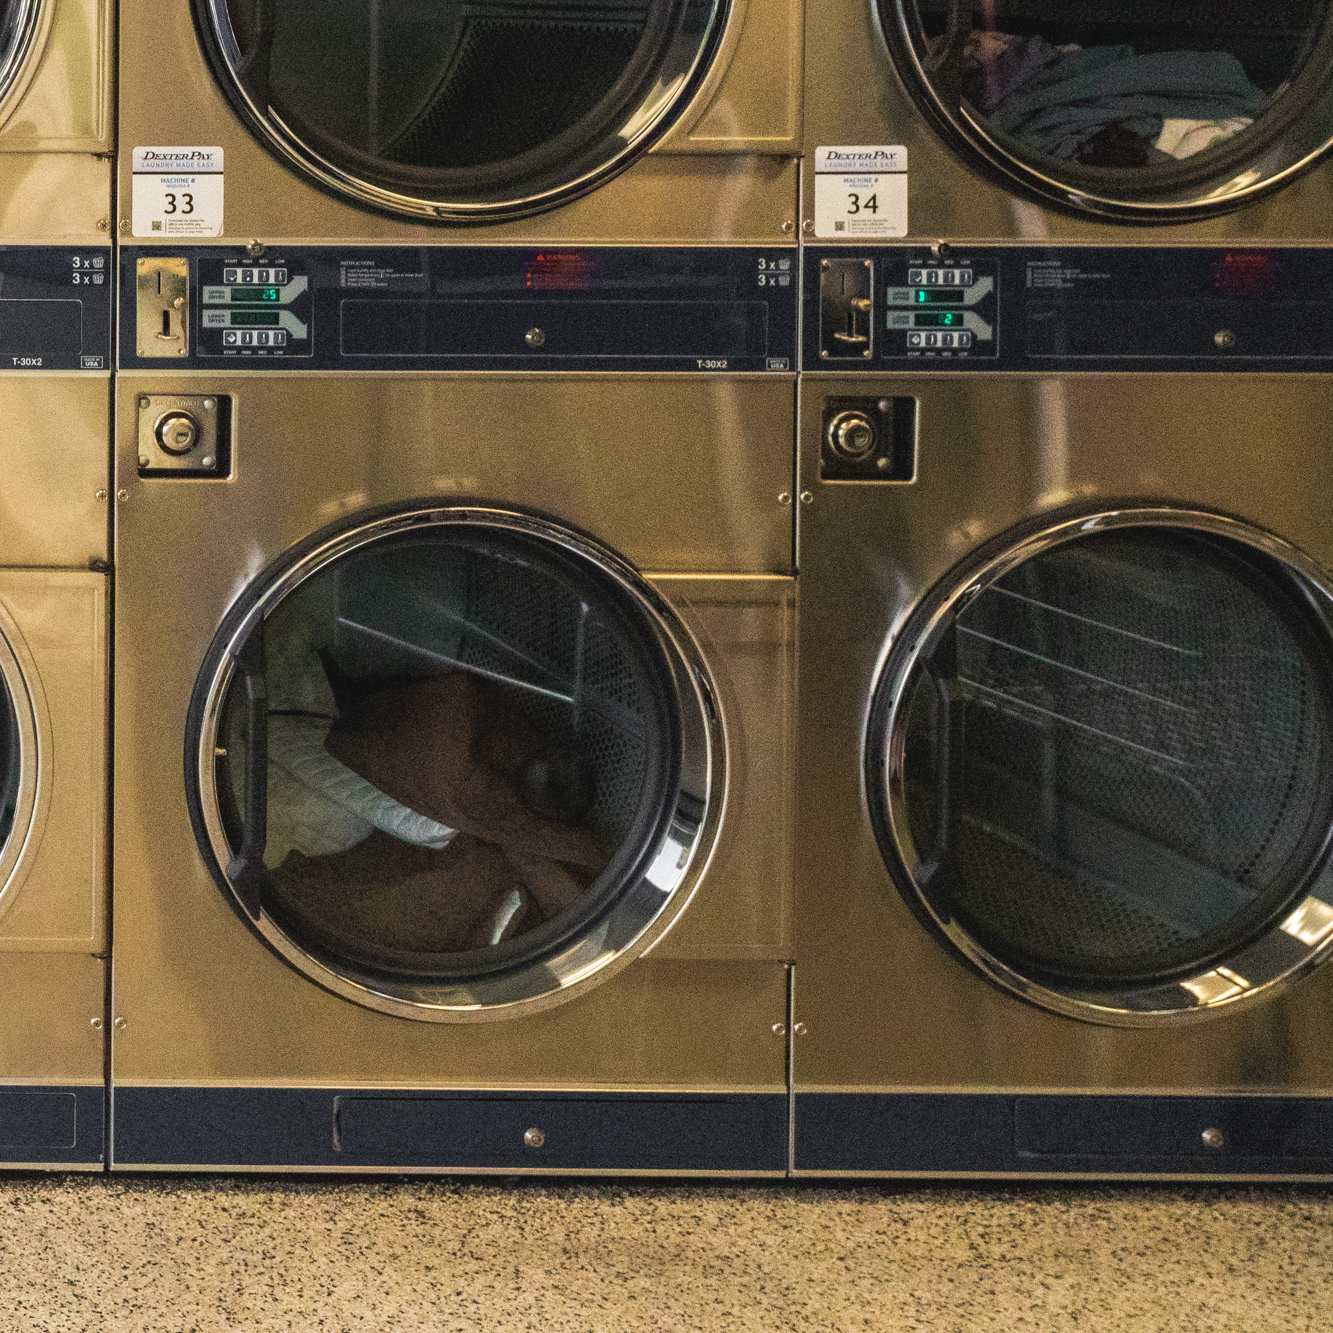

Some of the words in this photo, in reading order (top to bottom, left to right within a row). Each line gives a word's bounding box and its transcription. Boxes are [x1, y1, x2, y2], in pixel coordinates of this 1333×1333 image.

[164, 191, 195, 215] 33
[847, 192, 880, 215] 34
[12, 357, 42, 367] T-30X2
[697, 358, 727, 369] T-30X2
